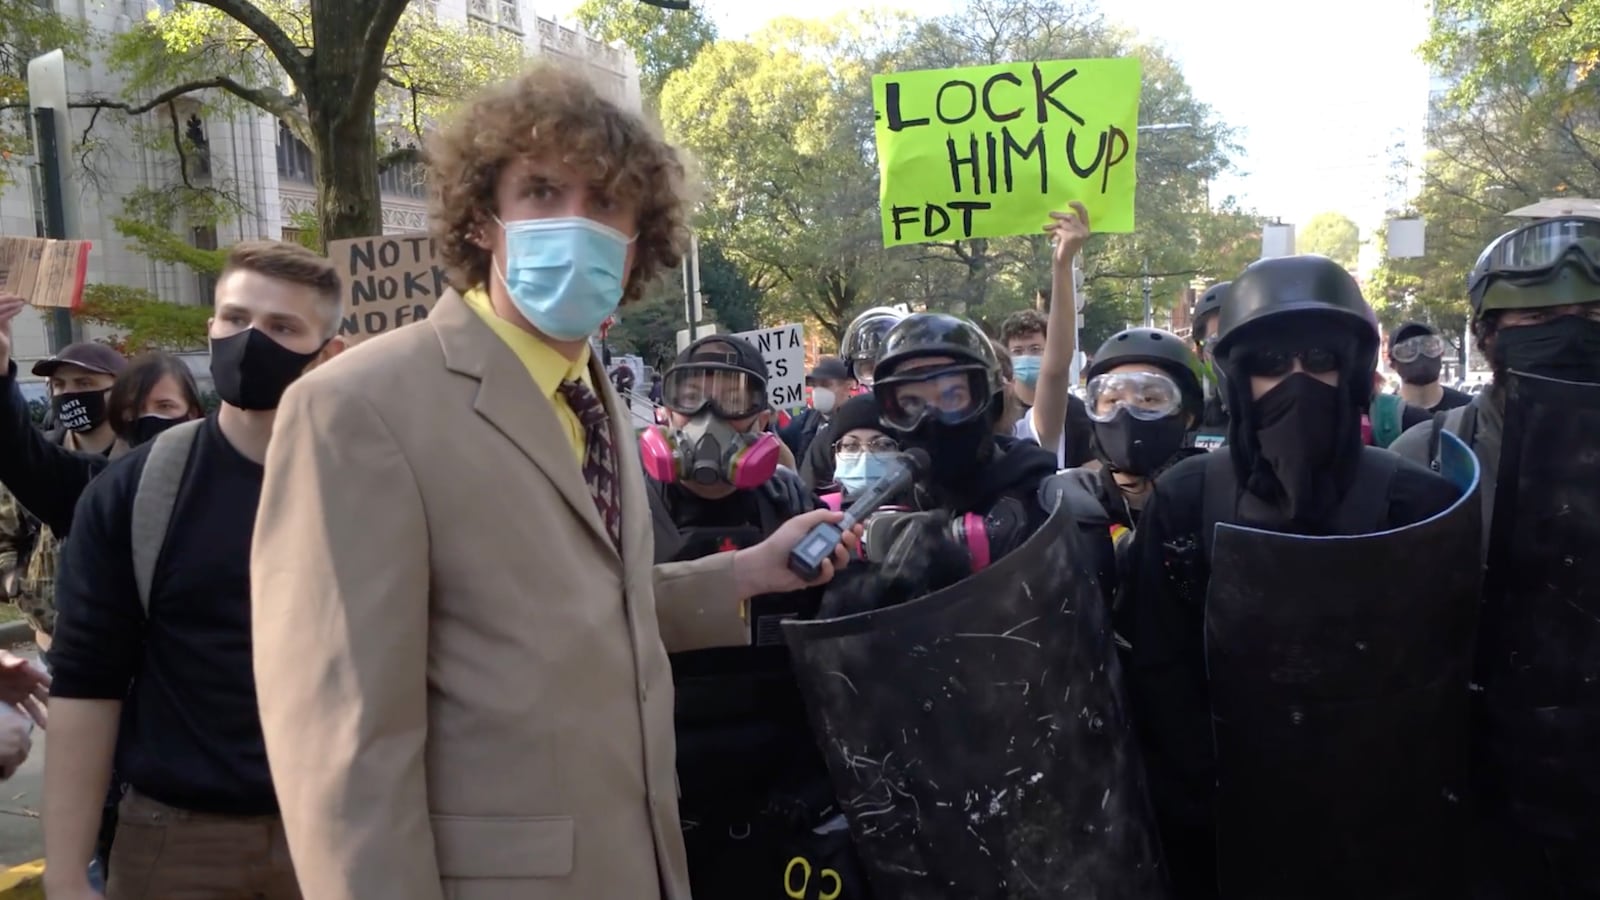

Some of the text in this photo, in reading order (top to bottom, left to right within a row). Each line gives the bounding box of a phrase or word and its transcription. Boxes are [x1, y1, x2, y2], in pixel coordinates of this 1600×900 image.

[886, 62, 1085, 131] LOCK
[947, 124, 1130, 194] HIM UP
[892, 201, 991, 240] FDT
[745, 328, 801, 353] NTA
